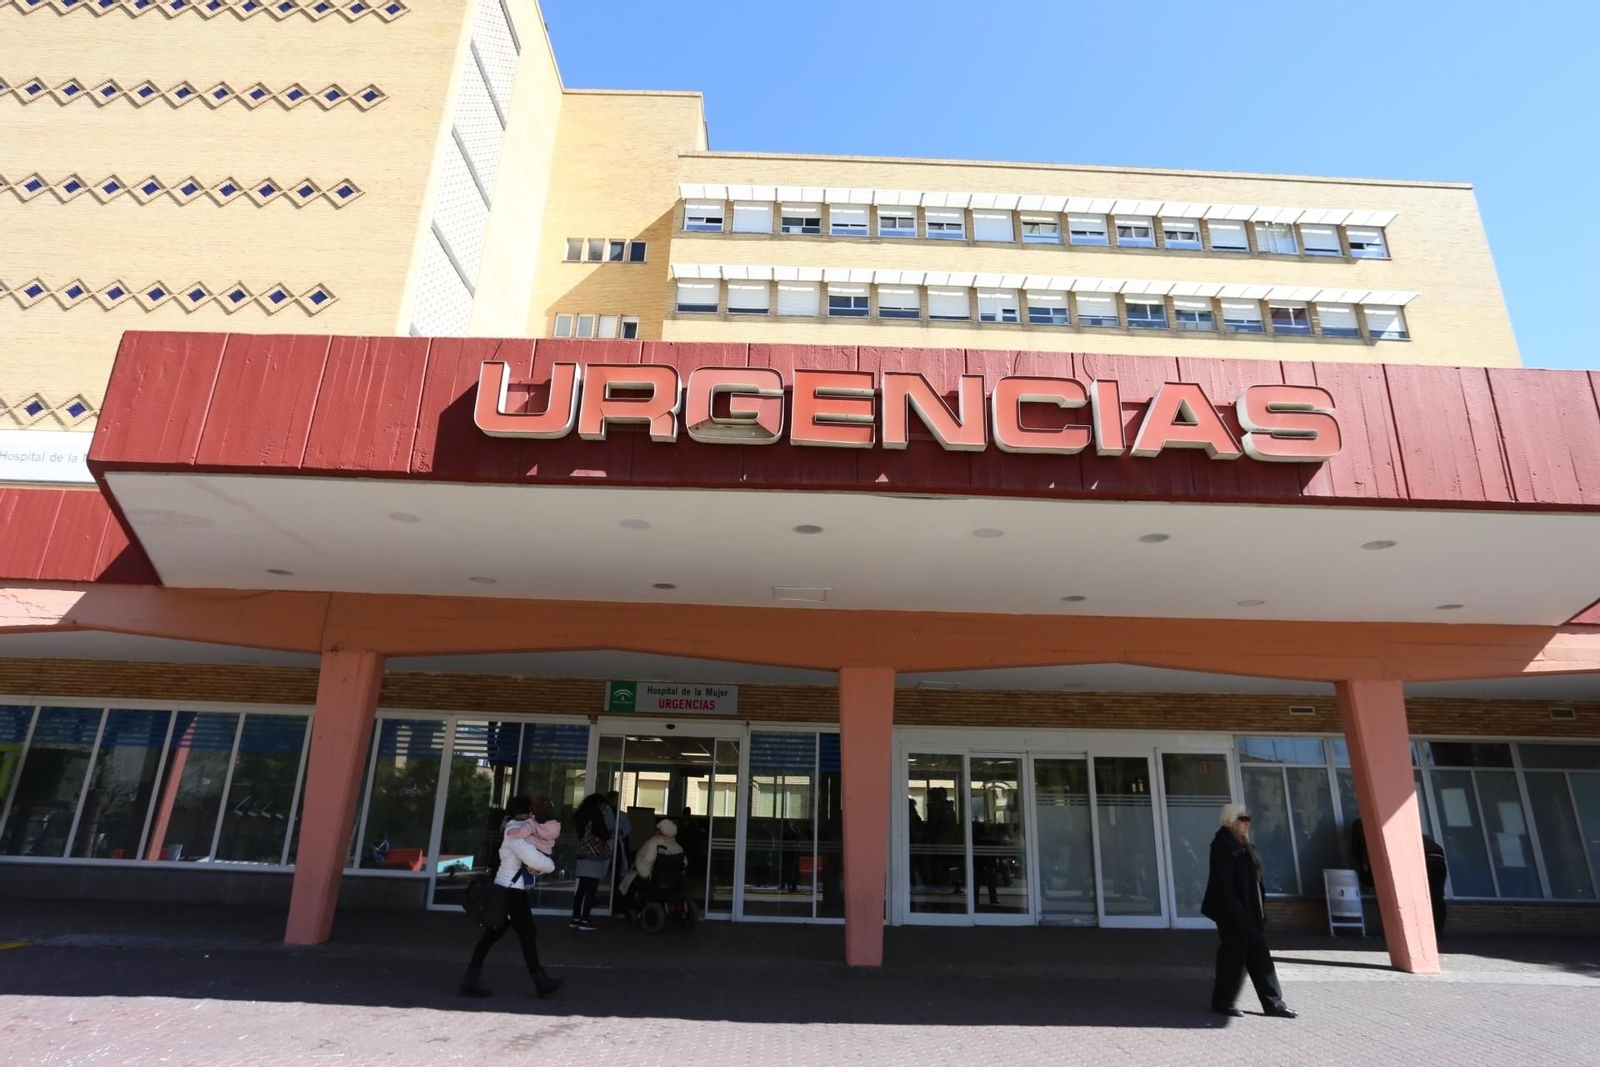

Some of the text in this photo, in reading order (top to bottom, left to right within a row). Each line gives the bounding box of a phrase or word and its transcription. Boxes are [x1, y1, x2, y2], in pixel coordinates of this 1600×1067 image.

[474, 360, 1342, 462] URGENCIAS
[49, 452, 64, 462] de
[68, 453, 78, 463] la
[647, 686, 729, 698] Hospital de la Mujer
[658, 698, 716, 710] URGENCIAS
